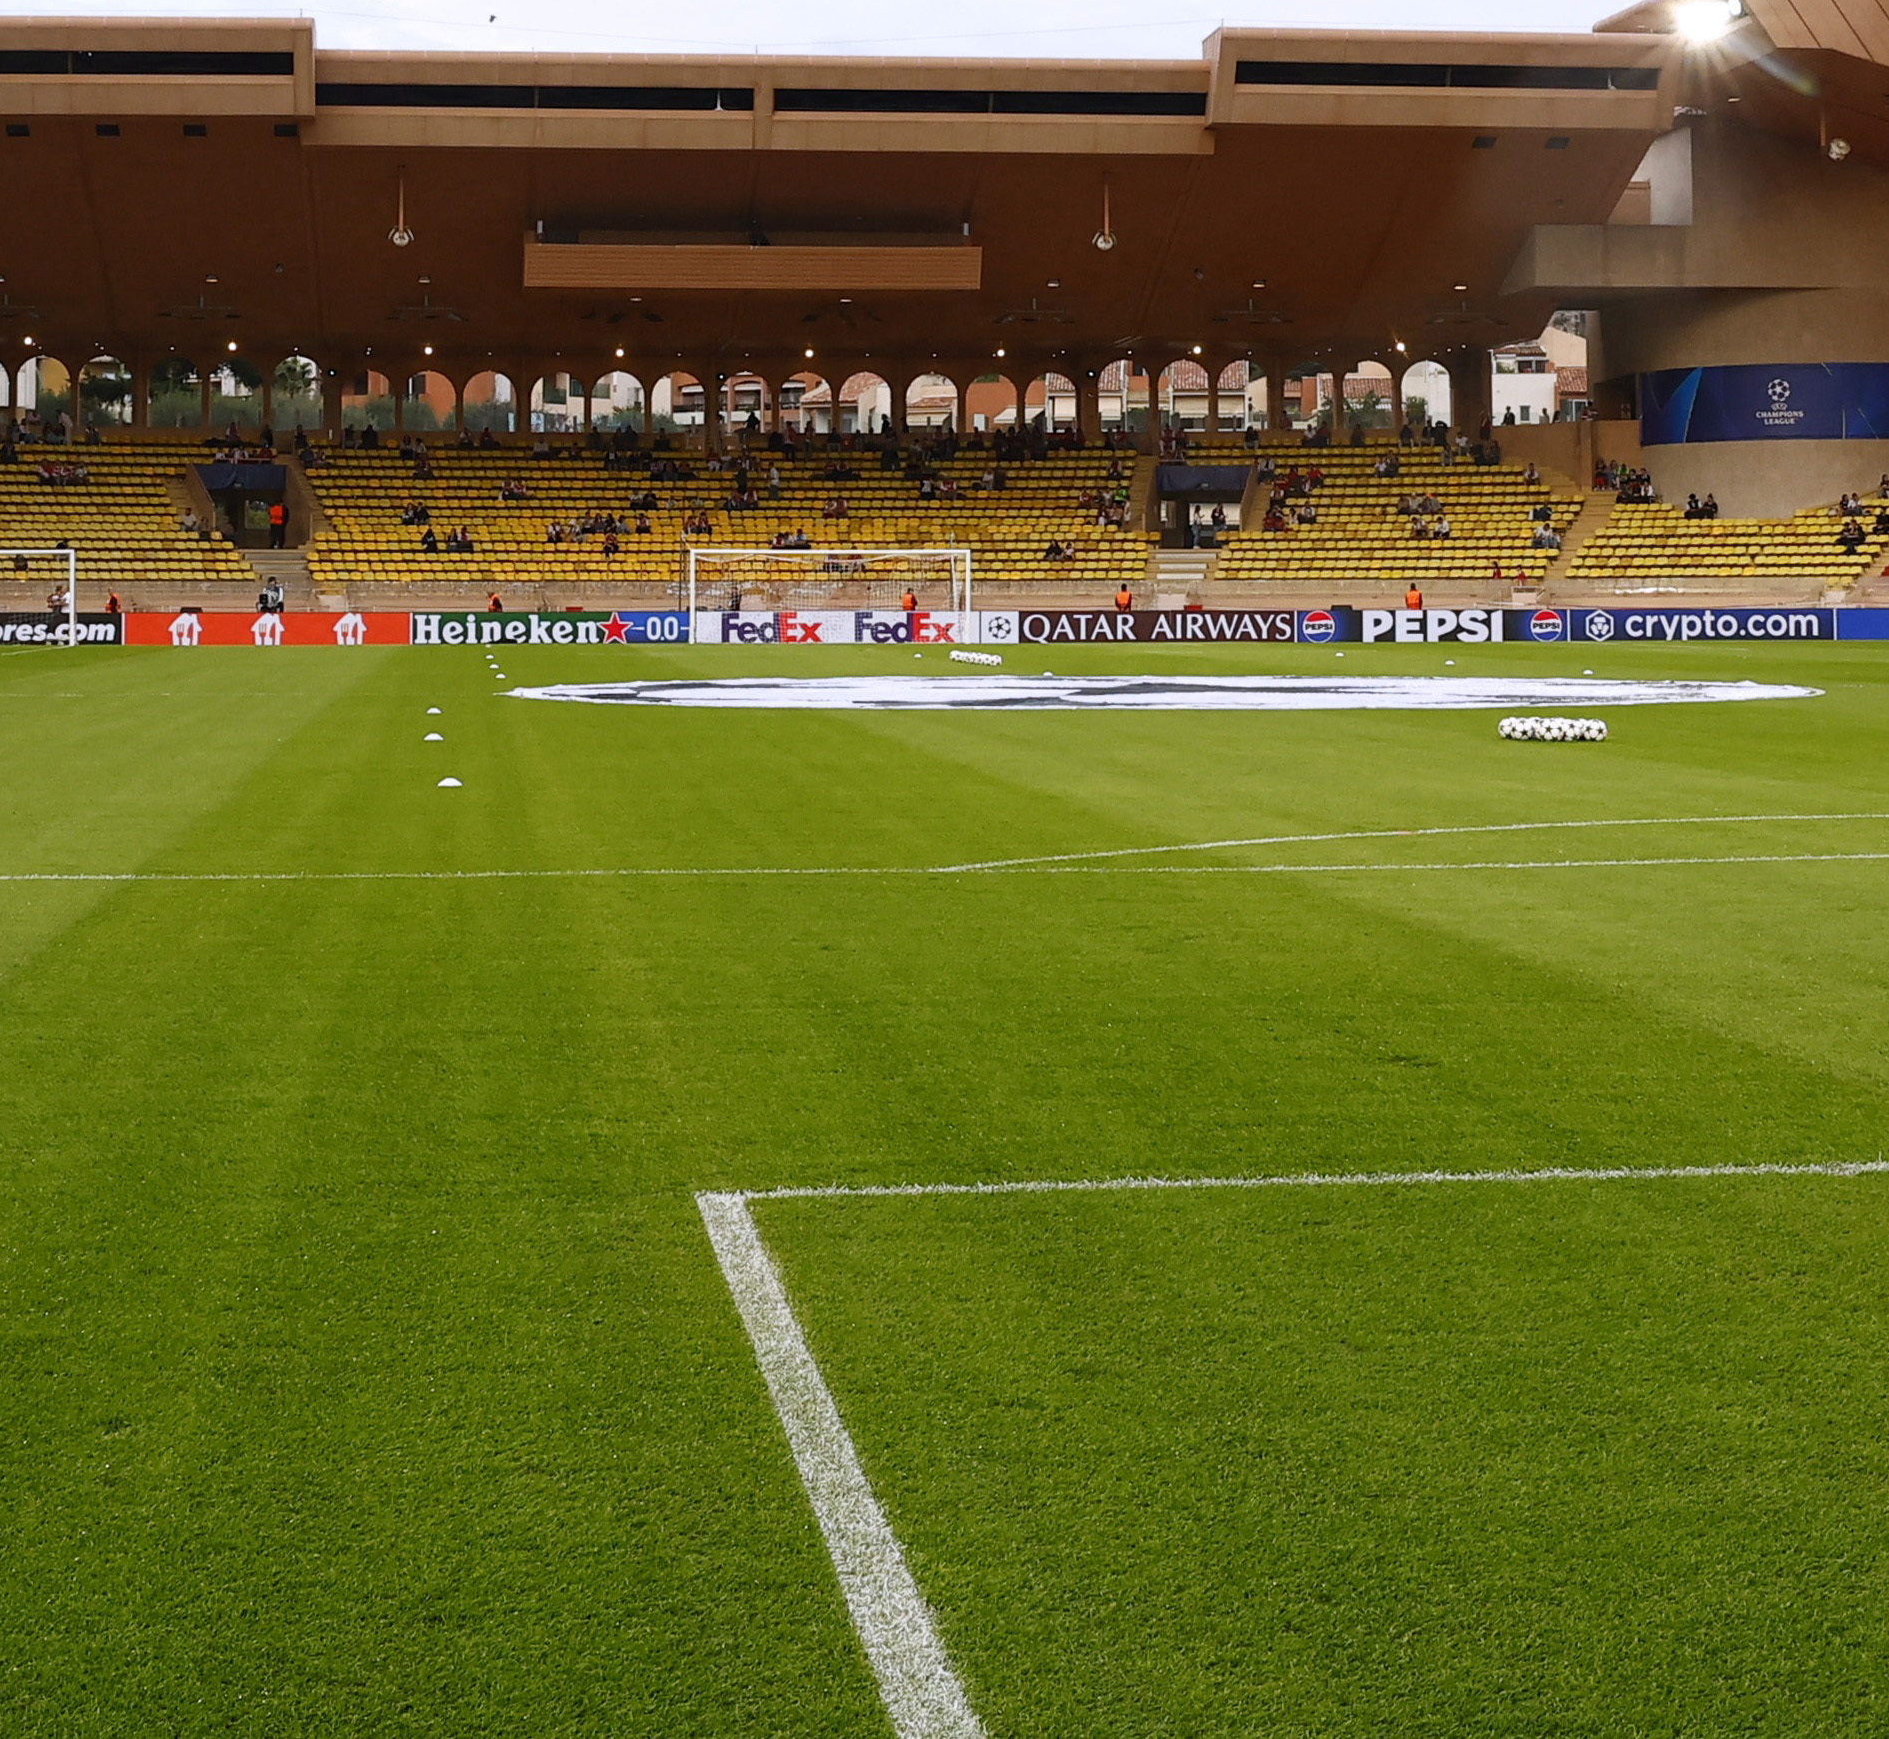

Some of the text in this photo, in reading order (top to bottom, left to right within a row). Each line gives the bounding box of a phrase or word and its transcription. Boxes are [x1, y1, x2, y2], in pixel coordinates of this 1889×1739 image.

[1755, 410, 1804, 418] CHAMPIONS
[414, 614, 599, 644] Heineken
[721, 612, 822, 643] FedEx
[854, 612, 955, 643] FedEx
[1023, 613, 1291, 643] QATAR AIRWAYS
[1305, 623, 1333, 631] PEPSI
[1362, 609, 1503, 643] PEPSI
[1533, 622, 1560, 630] PEPSI
[1625, 610, 1819, 641] crypto.com
